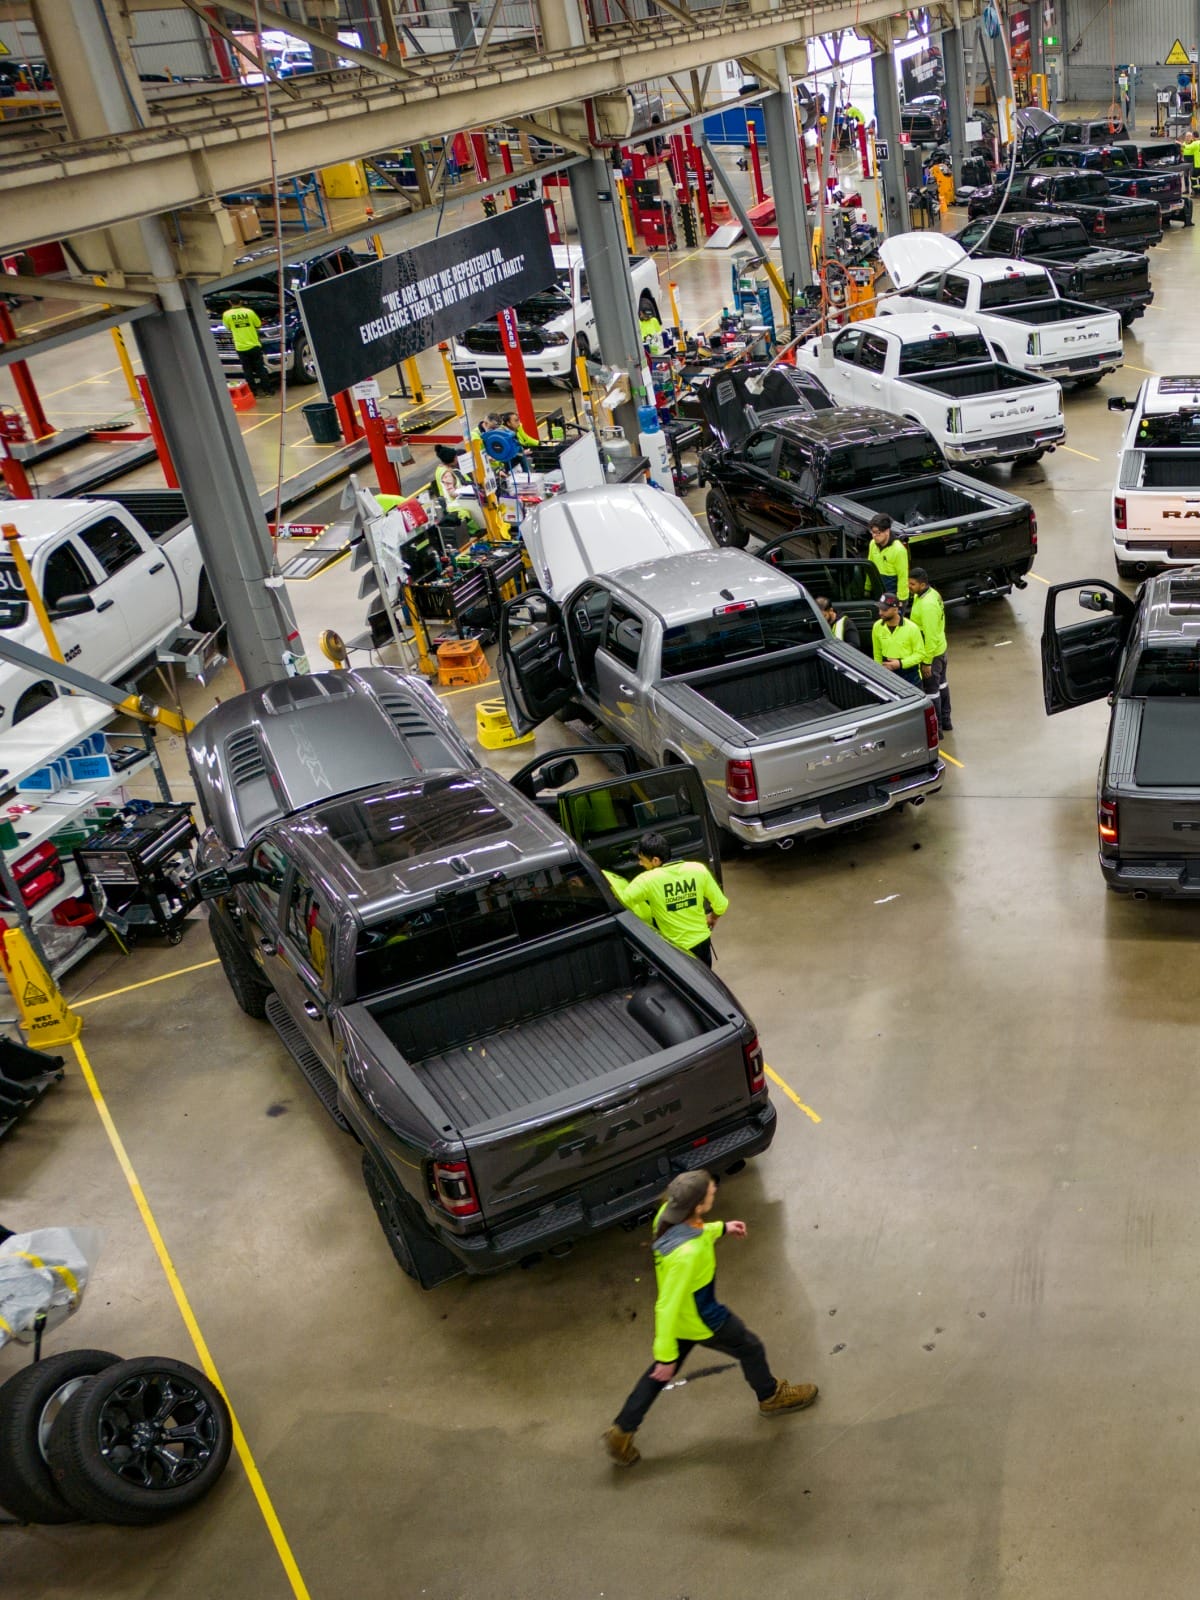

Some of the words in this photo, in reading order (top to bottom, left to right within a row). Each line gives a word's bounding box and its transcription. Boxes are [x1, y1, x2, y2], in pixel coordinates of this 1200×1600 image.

[876, 147, 887, 155] RT
[402, 284, 418, 305] ARE
[417, 274, 440, 298] WHAT
[439, 269, 453, 288] WE
[452, 252, 491, 283] REPEATEDLY
[492, 248, 504, 265] DO.
[360, 307, 410, 344] EXCELLENCE
[432, 293, 443, 311] IS
[442, 286, 457, 306] NOT
[458, 281, 469, 299] AN
[483, 268, 496, 287] BUT
[497, 266, 503, 281] A
[1063, 332, 1100, 344] RAM
[456, 375, 482, 392] RB
[990, 404, 1035, 420] RAM
[946, 532, 1001, 554] RAM
[806, 739, 886, 771] RAM
[664, 878, 697, 898] RAM
[31, 1019, 60, 1031] FLOOR
[34, 1014, 52, 1023] WET
[557, 1098, 682, 1160] RAM
